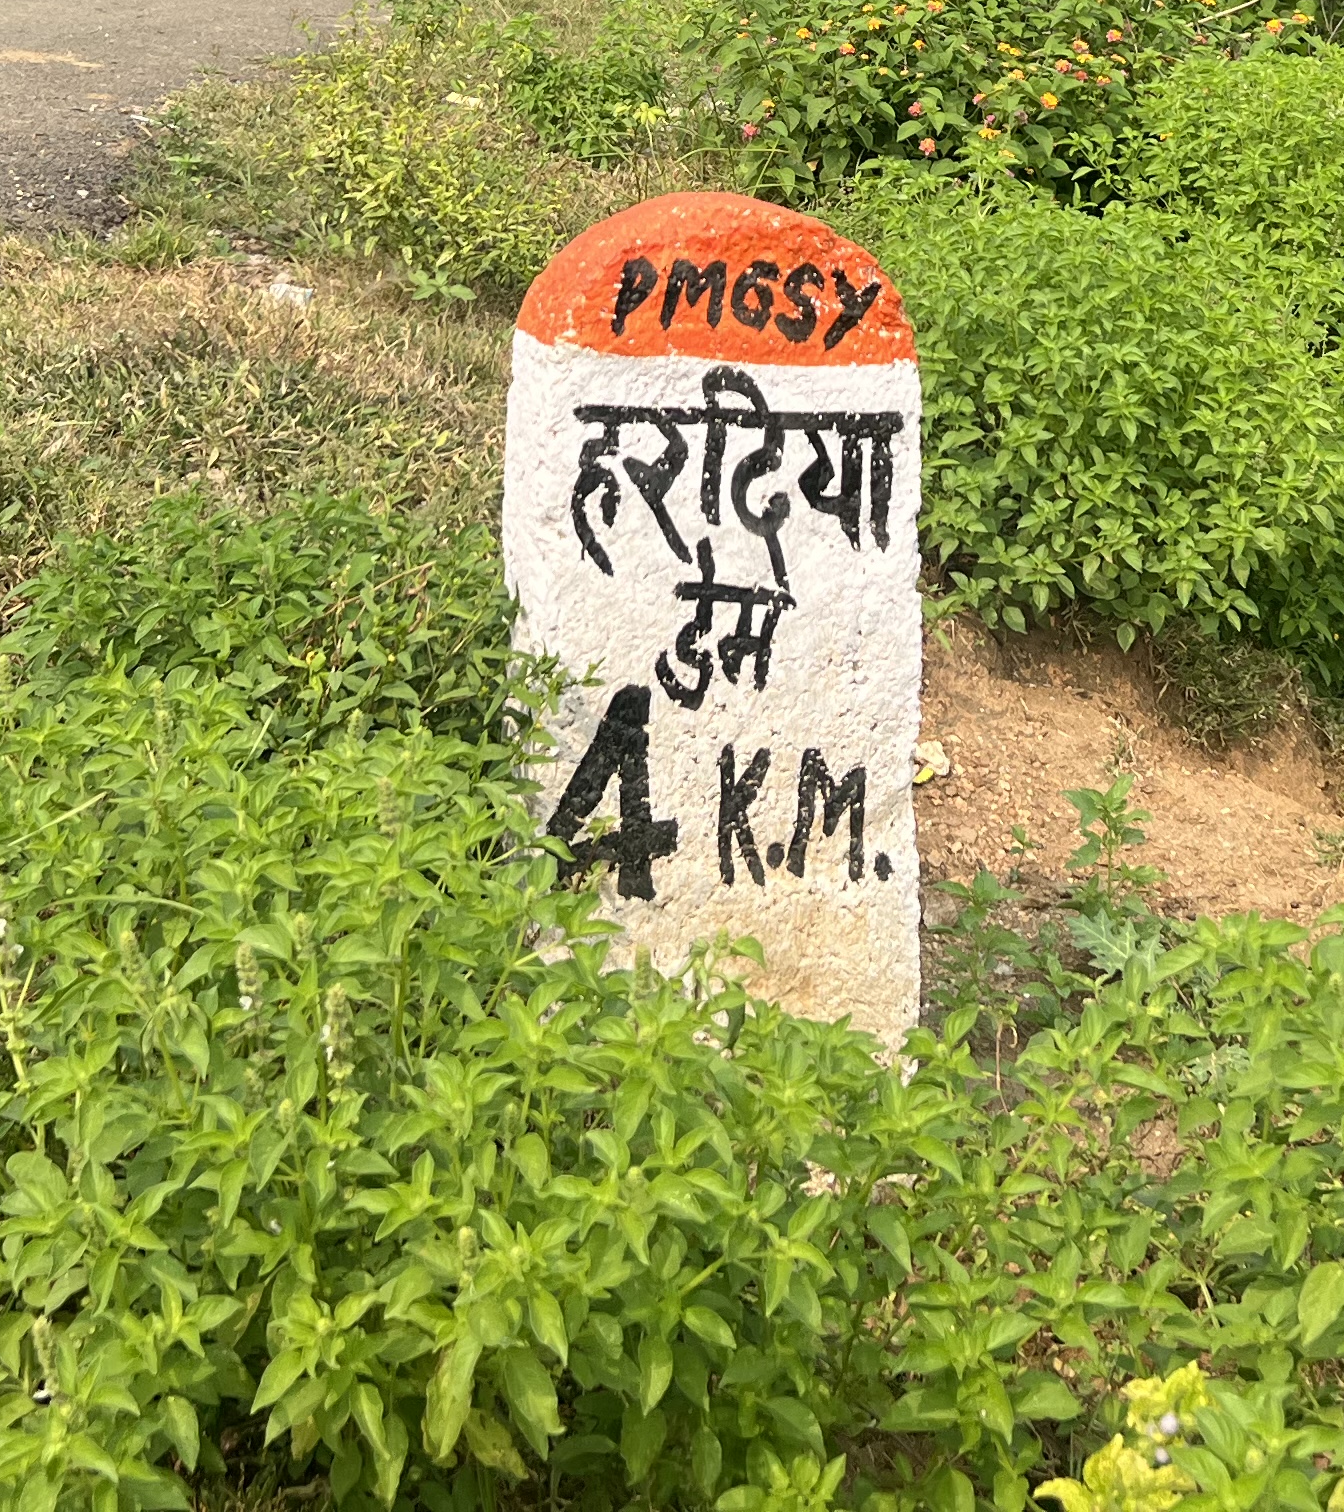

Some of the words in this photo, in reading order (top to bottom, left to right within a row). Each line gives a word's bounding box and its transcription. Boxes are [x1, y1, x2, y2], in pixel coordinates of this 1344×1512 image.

[610, 259, 883, 352] PMGSY
[569, 366, 905, 596] हरदिया
[654, 537, 798, 712] डेम
[546, 684, 679, 902] 4
[716, 743, 894, 888] K.M.
